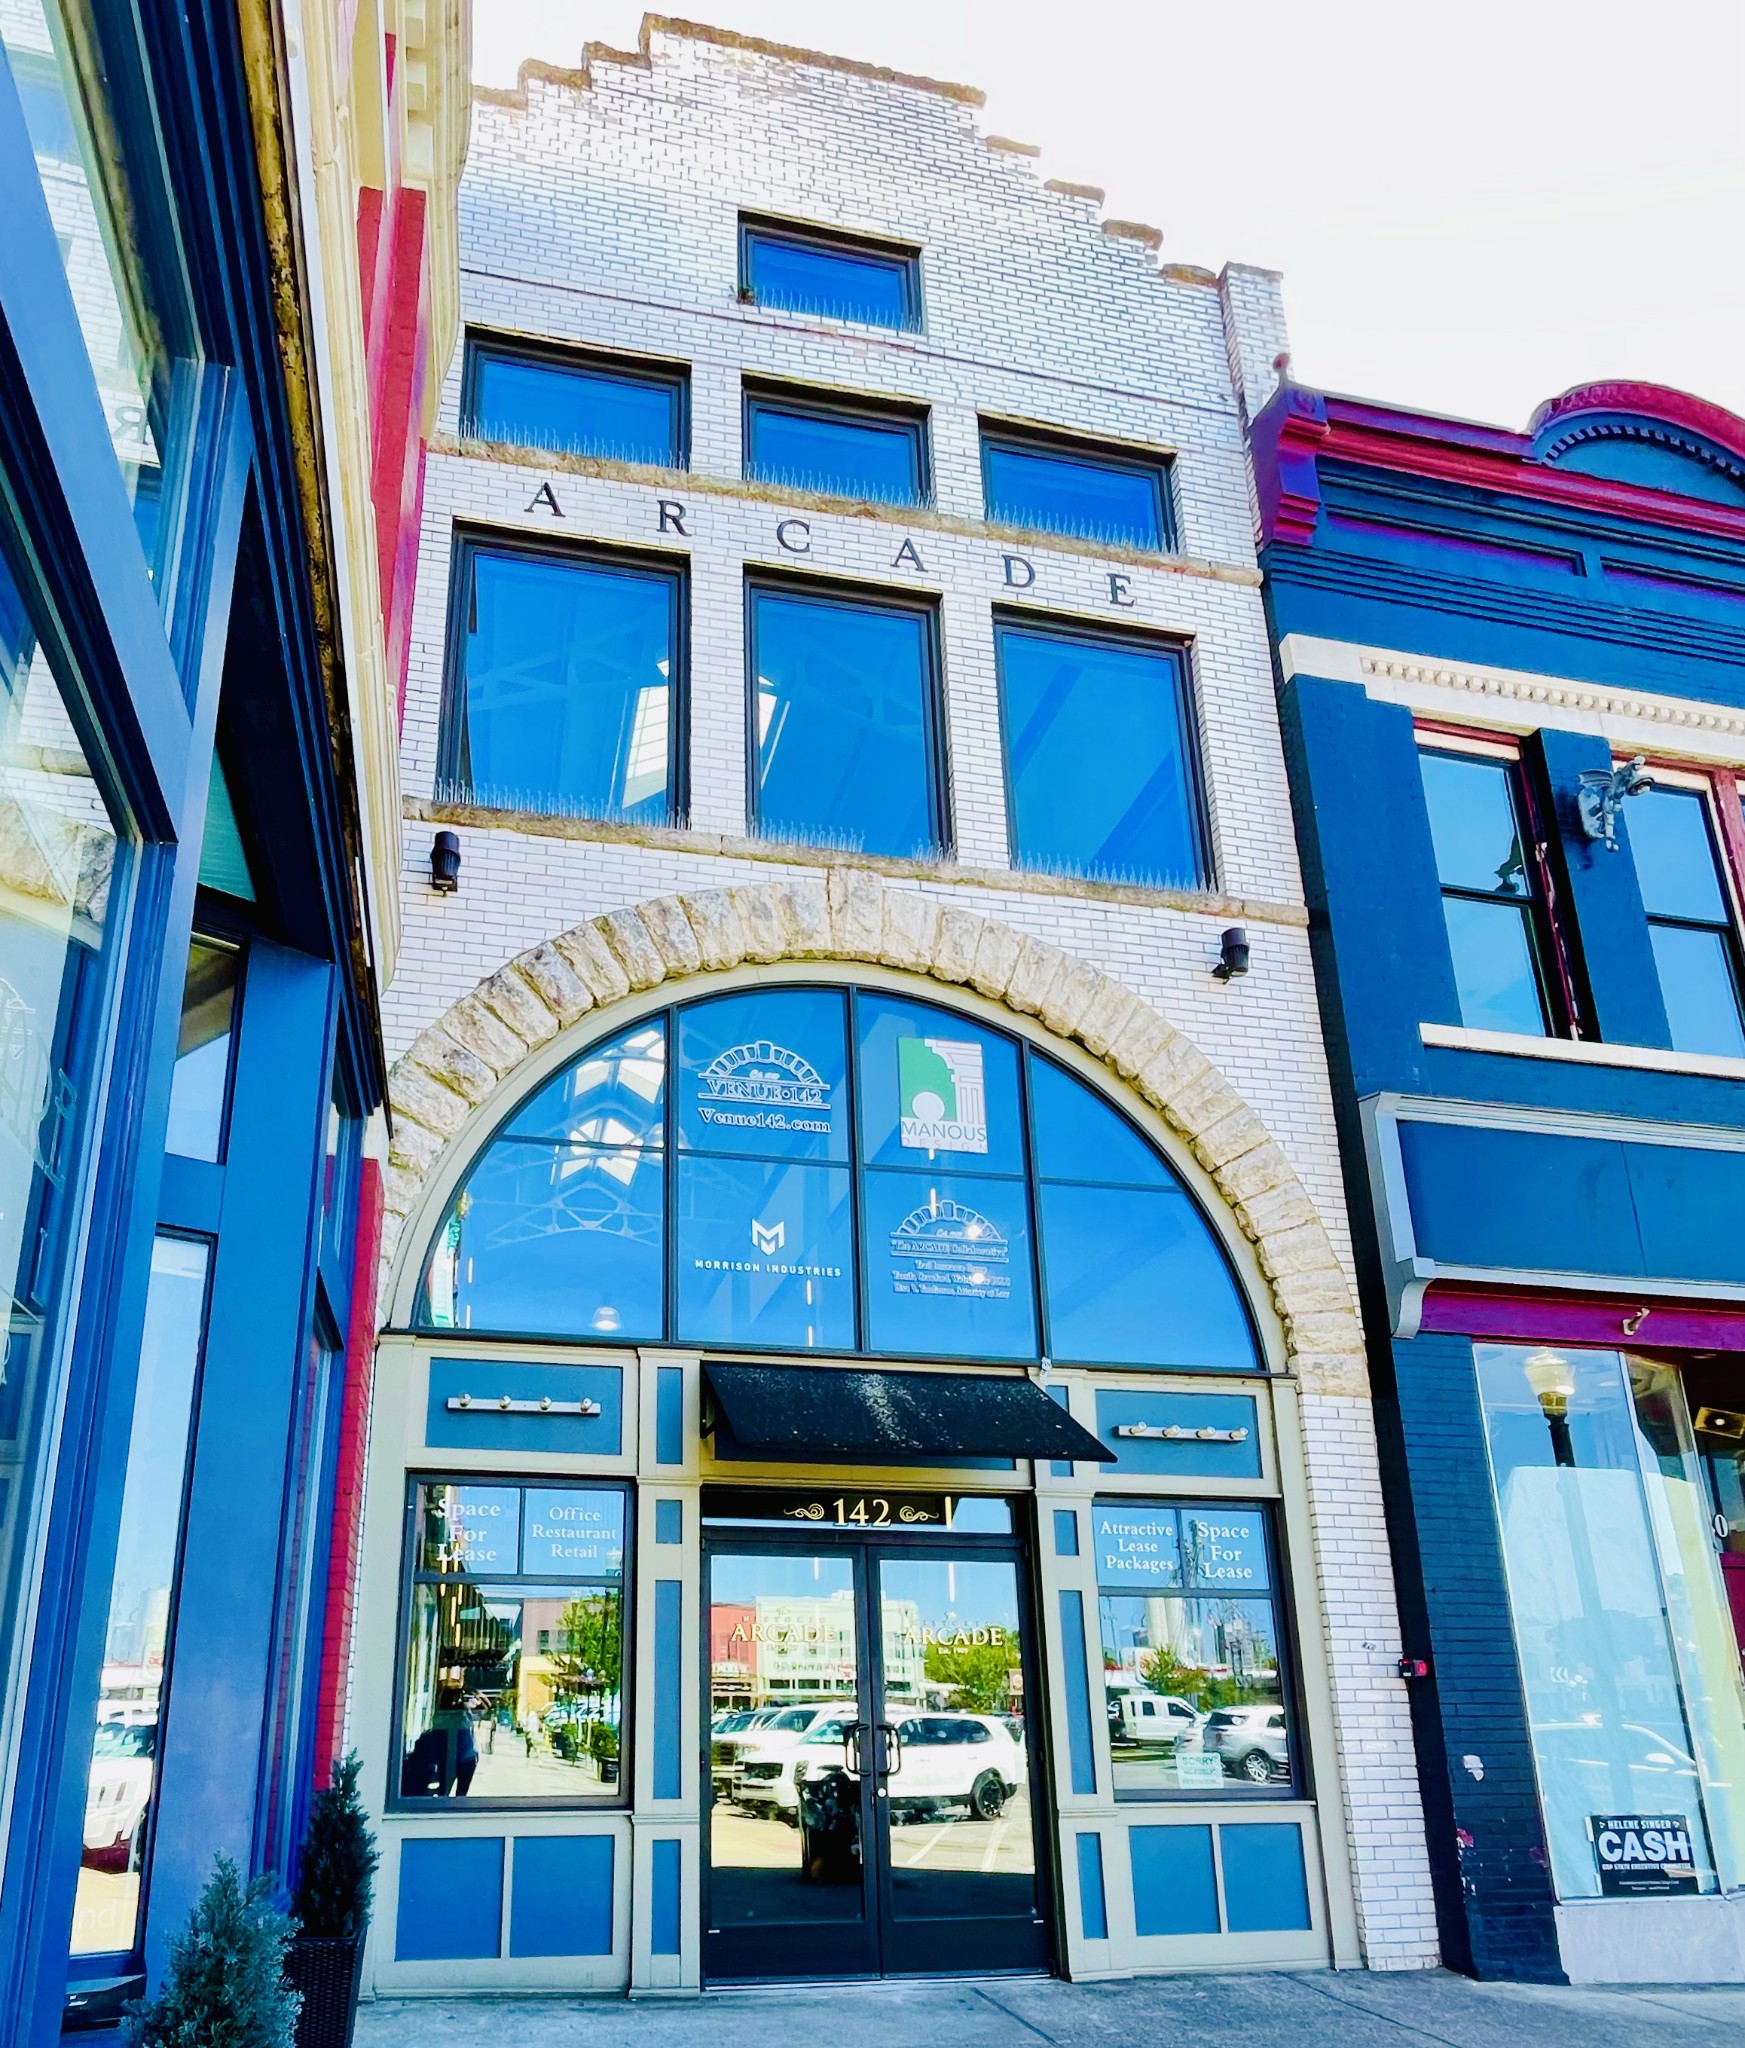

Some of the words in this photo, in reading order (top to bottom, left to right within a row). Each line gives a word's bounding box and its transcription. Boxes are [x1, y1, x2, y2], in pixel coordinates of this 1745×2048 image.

[524, 482, 1135, 607] ARCADE
[698, 1108, 832, 1133] Venue142.com
[901, 1120, 987, 1142] MANOUS
[695, 1259, 760, 1272] MORRISON
[766, 1263, 841, 1277] INDUSTRIES
[436, 1498, 501, 1521] Space
[549, 1506, 601, 1521] Office
[832, 1498, 892, 1527] 142
[448, 1524, 488, 1542] For
[531, 1524, 617, 1541] Restaurant
[1100, 1521, 1174, 1537] Attractive
[1197, 1521, 1250, 1543] Space
[436, 1543, 498, 1562] Lease
[551, 1544, 598, 1559] Retail
[1117, 1538, 1159, 1553] Lease
[1211, 1545, 1243, 1562] For
[1105, 1555, 1174, 1573] Packages
[1204, 1563, 1254, 1579] Lease
[730, 1623, 836, 1643] ARCADE
[903, 1626, 1004, 1647] ARCADE
[1607, 1820, 1640, 1830] HELENE
[1641, 1820, 1672, 1830] SINGER
[1598, 1830, 1691, 1862] CASH
